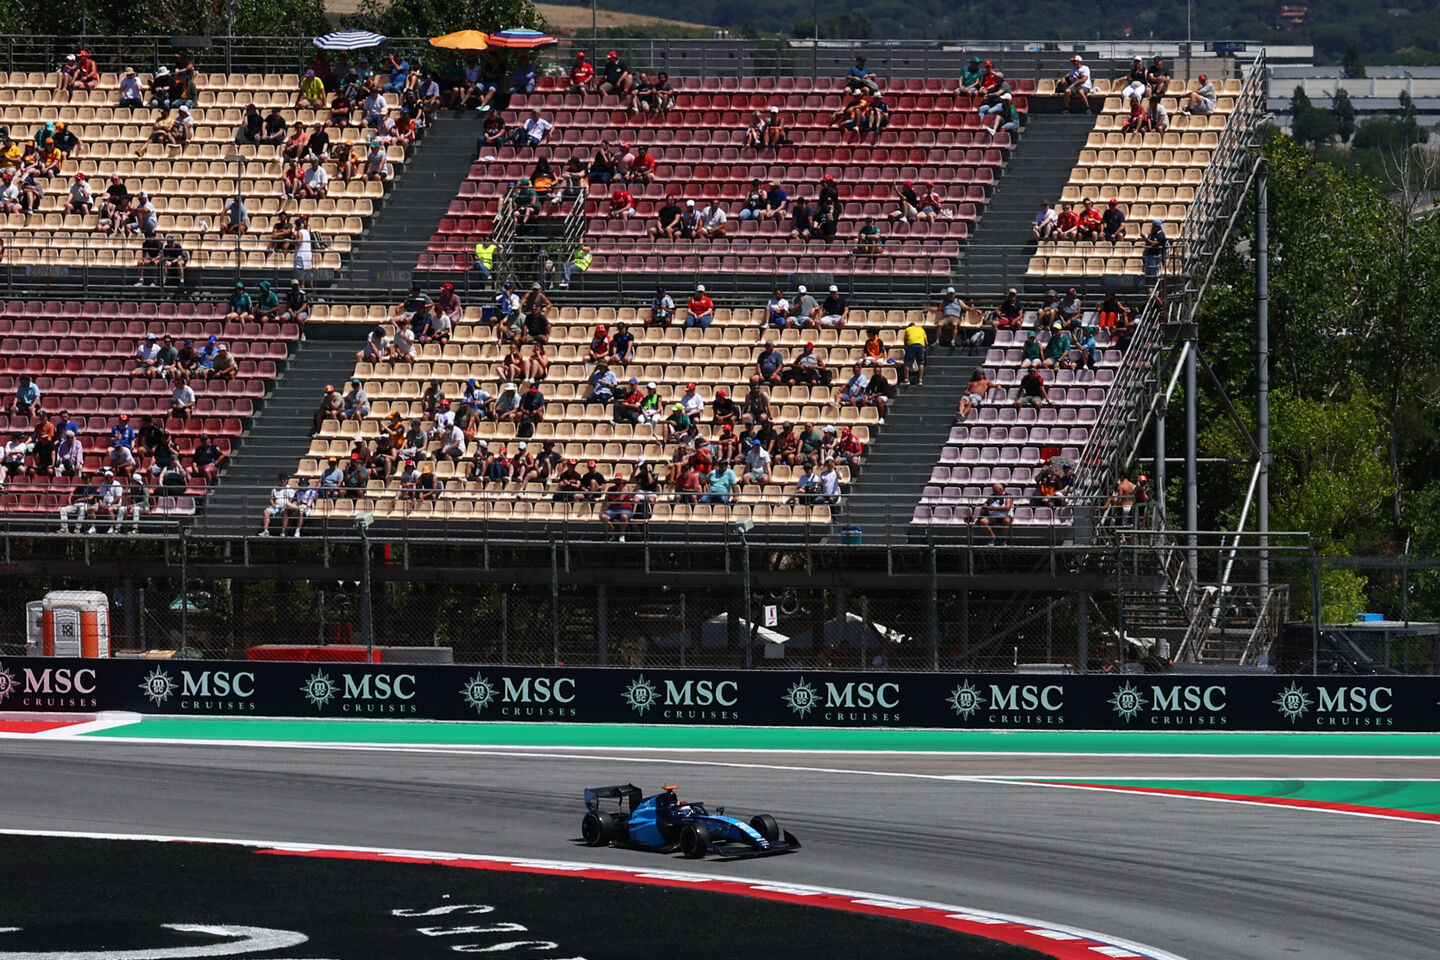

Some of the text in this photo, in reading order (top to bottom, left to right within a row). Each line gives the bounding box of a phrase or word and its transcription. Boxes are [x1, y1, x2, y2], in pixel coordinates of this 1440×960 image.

[23, 668, 97, 694] MSC
[181, 670, 255, 698] MSC
[342, 673, 416, 700] MSC
[501, 677, 576, 703] MSC
[23, 697, 97, 706] CRUISES
[663, 679, 738, 707] MSC
[824, 682, 900, 709] MSC
[988, 684, 1064, 711] MSC
[1151, 685, 1226, 712] MSC
[1316, 686, 1393, 713] MSC
[181, 699, 255, 710] CRUISES
[342, 702, 416, 712] CRUISES
[501, 706, 576, 715] CRUISES
[663, 708, 738, 719] CRUISES
[824, 711, 900, 721] CRUISES
[988, 713, 1064, 723] CRUISES
[1151, 716, 1226, 725] CRUISES
[1316, 717, 1393, 726] CRUISES
